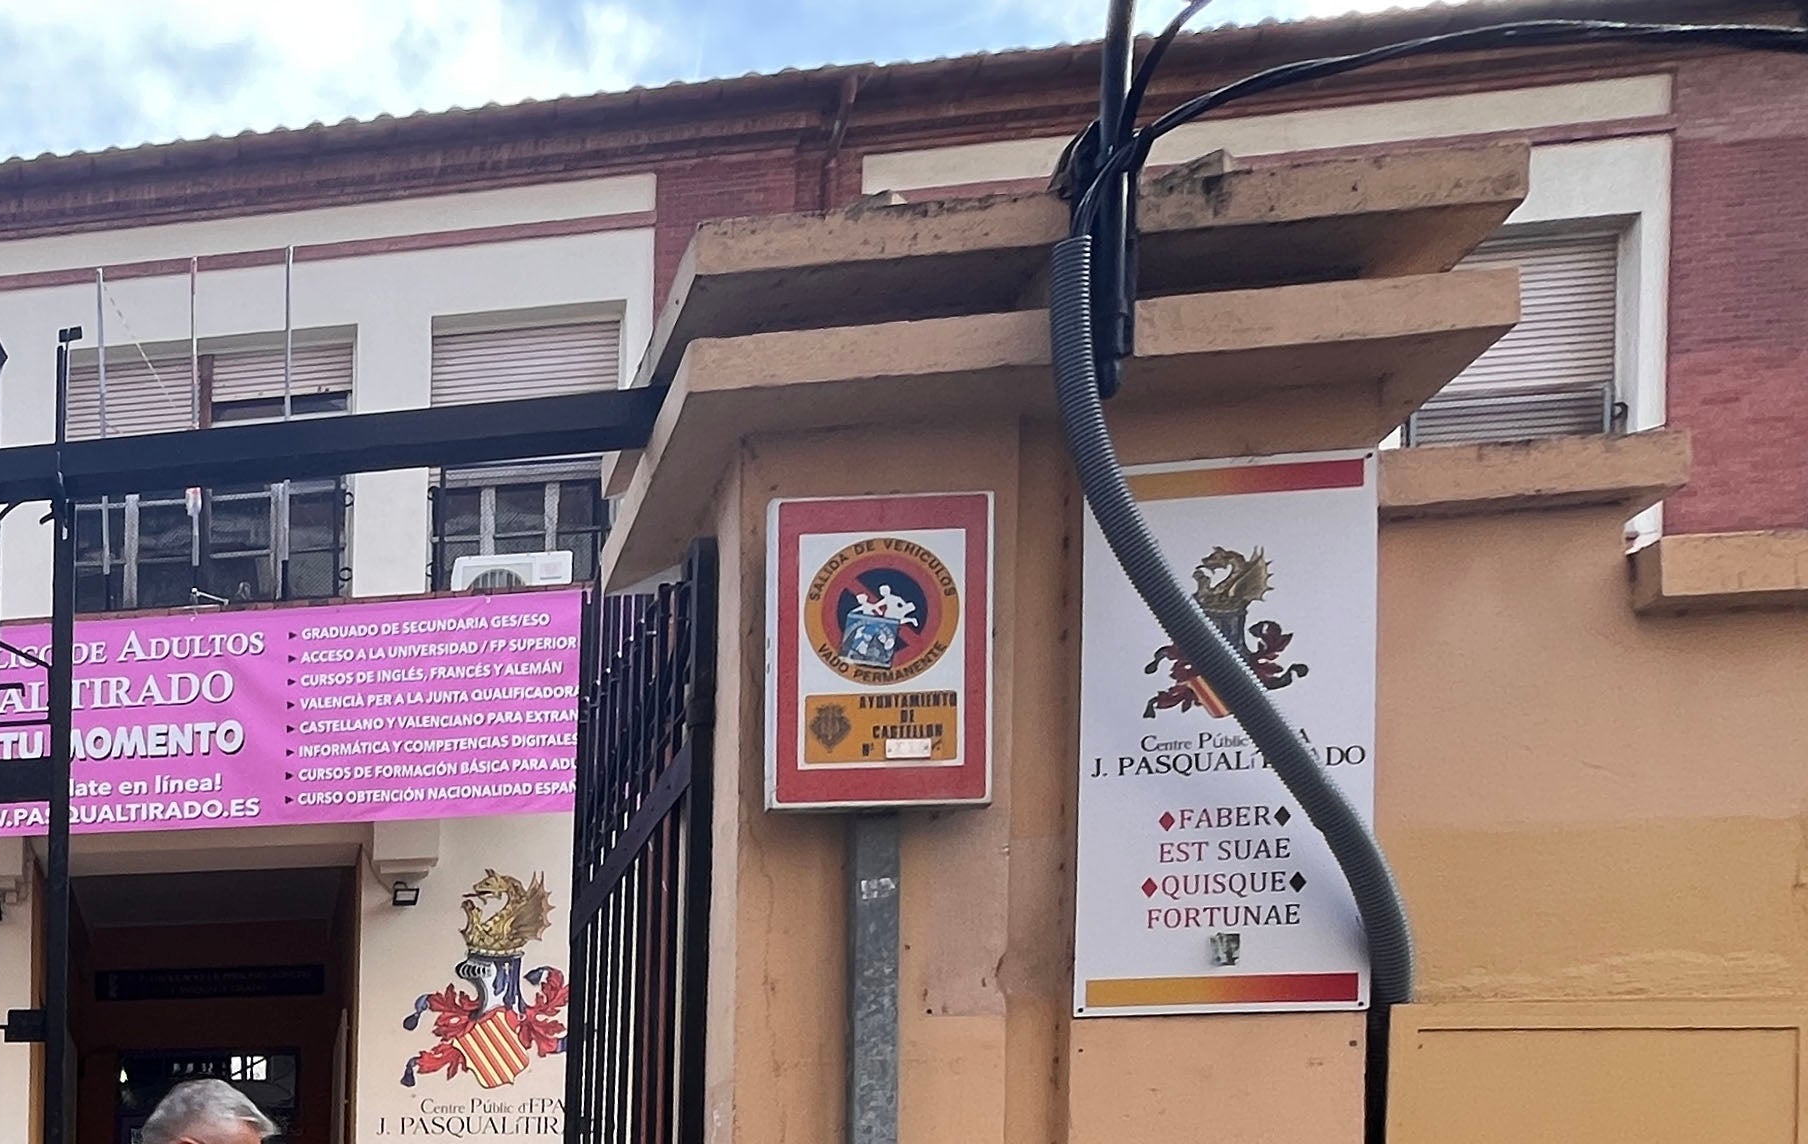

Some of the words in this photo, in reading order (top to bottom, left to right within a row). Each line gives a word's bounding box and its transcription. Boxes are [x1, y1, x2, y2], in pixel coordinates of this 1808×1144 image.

[809, 553, 849, 601] SALIDA
[854, 540, 875, 555] DE
[302, 624, 378, 640] GRADUADO
[382, 623, 399, 636] DE
[402, 617, 489, 634] SECUNDARIA
[491, 613, 550, 628] GES/ESO
[116, 630, 265, 662] ADULTOS
[301, 649, 354, 663] ACCESO
[356, 648, 366, 660] A
[369, 647, 386, 659] LA
[388, 641, 478, 658] UNIVERSIDAD
[490, 639, 507, 651] FP
[509, 636, 577, 651] SUPERIOR
[300, 672, 354, 686] CURSOS
[357, 671, 374, 684] DE
[377, 666, 428, 682] INGLÉS,
[430, 662, 491, 679] FRANCÉS
[493, 663, 503, 676] Y
[504, 659, 563, 675] ALEMÁN
[818, 643, 850, 674] VADO
[853, 640, 947, 683] PERMANENTE
[300, 692, 364, 710] VALENCIÀ
[367, 694, 392, 707] PER
[394, 693, 404, 705] A
[407, 692, 425, 704] LA
[427, 690, 469, 704] JUNTA
[299, 718, 384, 733] CASTELLANO
[386, 717, 397, 728] Y
[398, 713, 484, 729] VALENCIANO
[487, 711, 523, 724] PARA
[526, 709, 578, 723] EXTRAN
[900, 709, 914, 723] DE
[299, 740, 390, 757] INFORMÁTICA
[392, 741, 403, 752] Y
[404, 735, 509, 752] COMPETENCIAS
[512, 733, 578, 747] DIGITALES
[1141, 735, 1193, 752] Centre
[1199, 732, 1250, 749] Públic
[298, 767, 351, 781] CURSOS
[354, 766, 372, 778] DE
[375, 761, 457, 777] FORMACIÓN
[460, 758, 509, 774] BÁSICA
[512, 759, 547, 771] PARA
[1091, 758, 1107, 777] J.
[119, 782, 148, 795] en
[155, 773, 222, 794] línea!
[298, 791, 343, 805] CURSO
[346, 787, 424, 803] OBTENCIÓN
[427, 783, 532, 800] NACIONALIDAD
[1179, 806, 1271, 829] FABER
[1159, 841, 1209, 863] EST
[1217, 838, 1291, 861] SUAE
[1161, 871, 1286, 900] QUISQUE
[1147, 904, 1301, 929] FORTUNAE
[420, 1098, 466, 1114] Centre
[470, 1097, 514, 1114] Públic
[376, 1117, 390, 1135] J.
